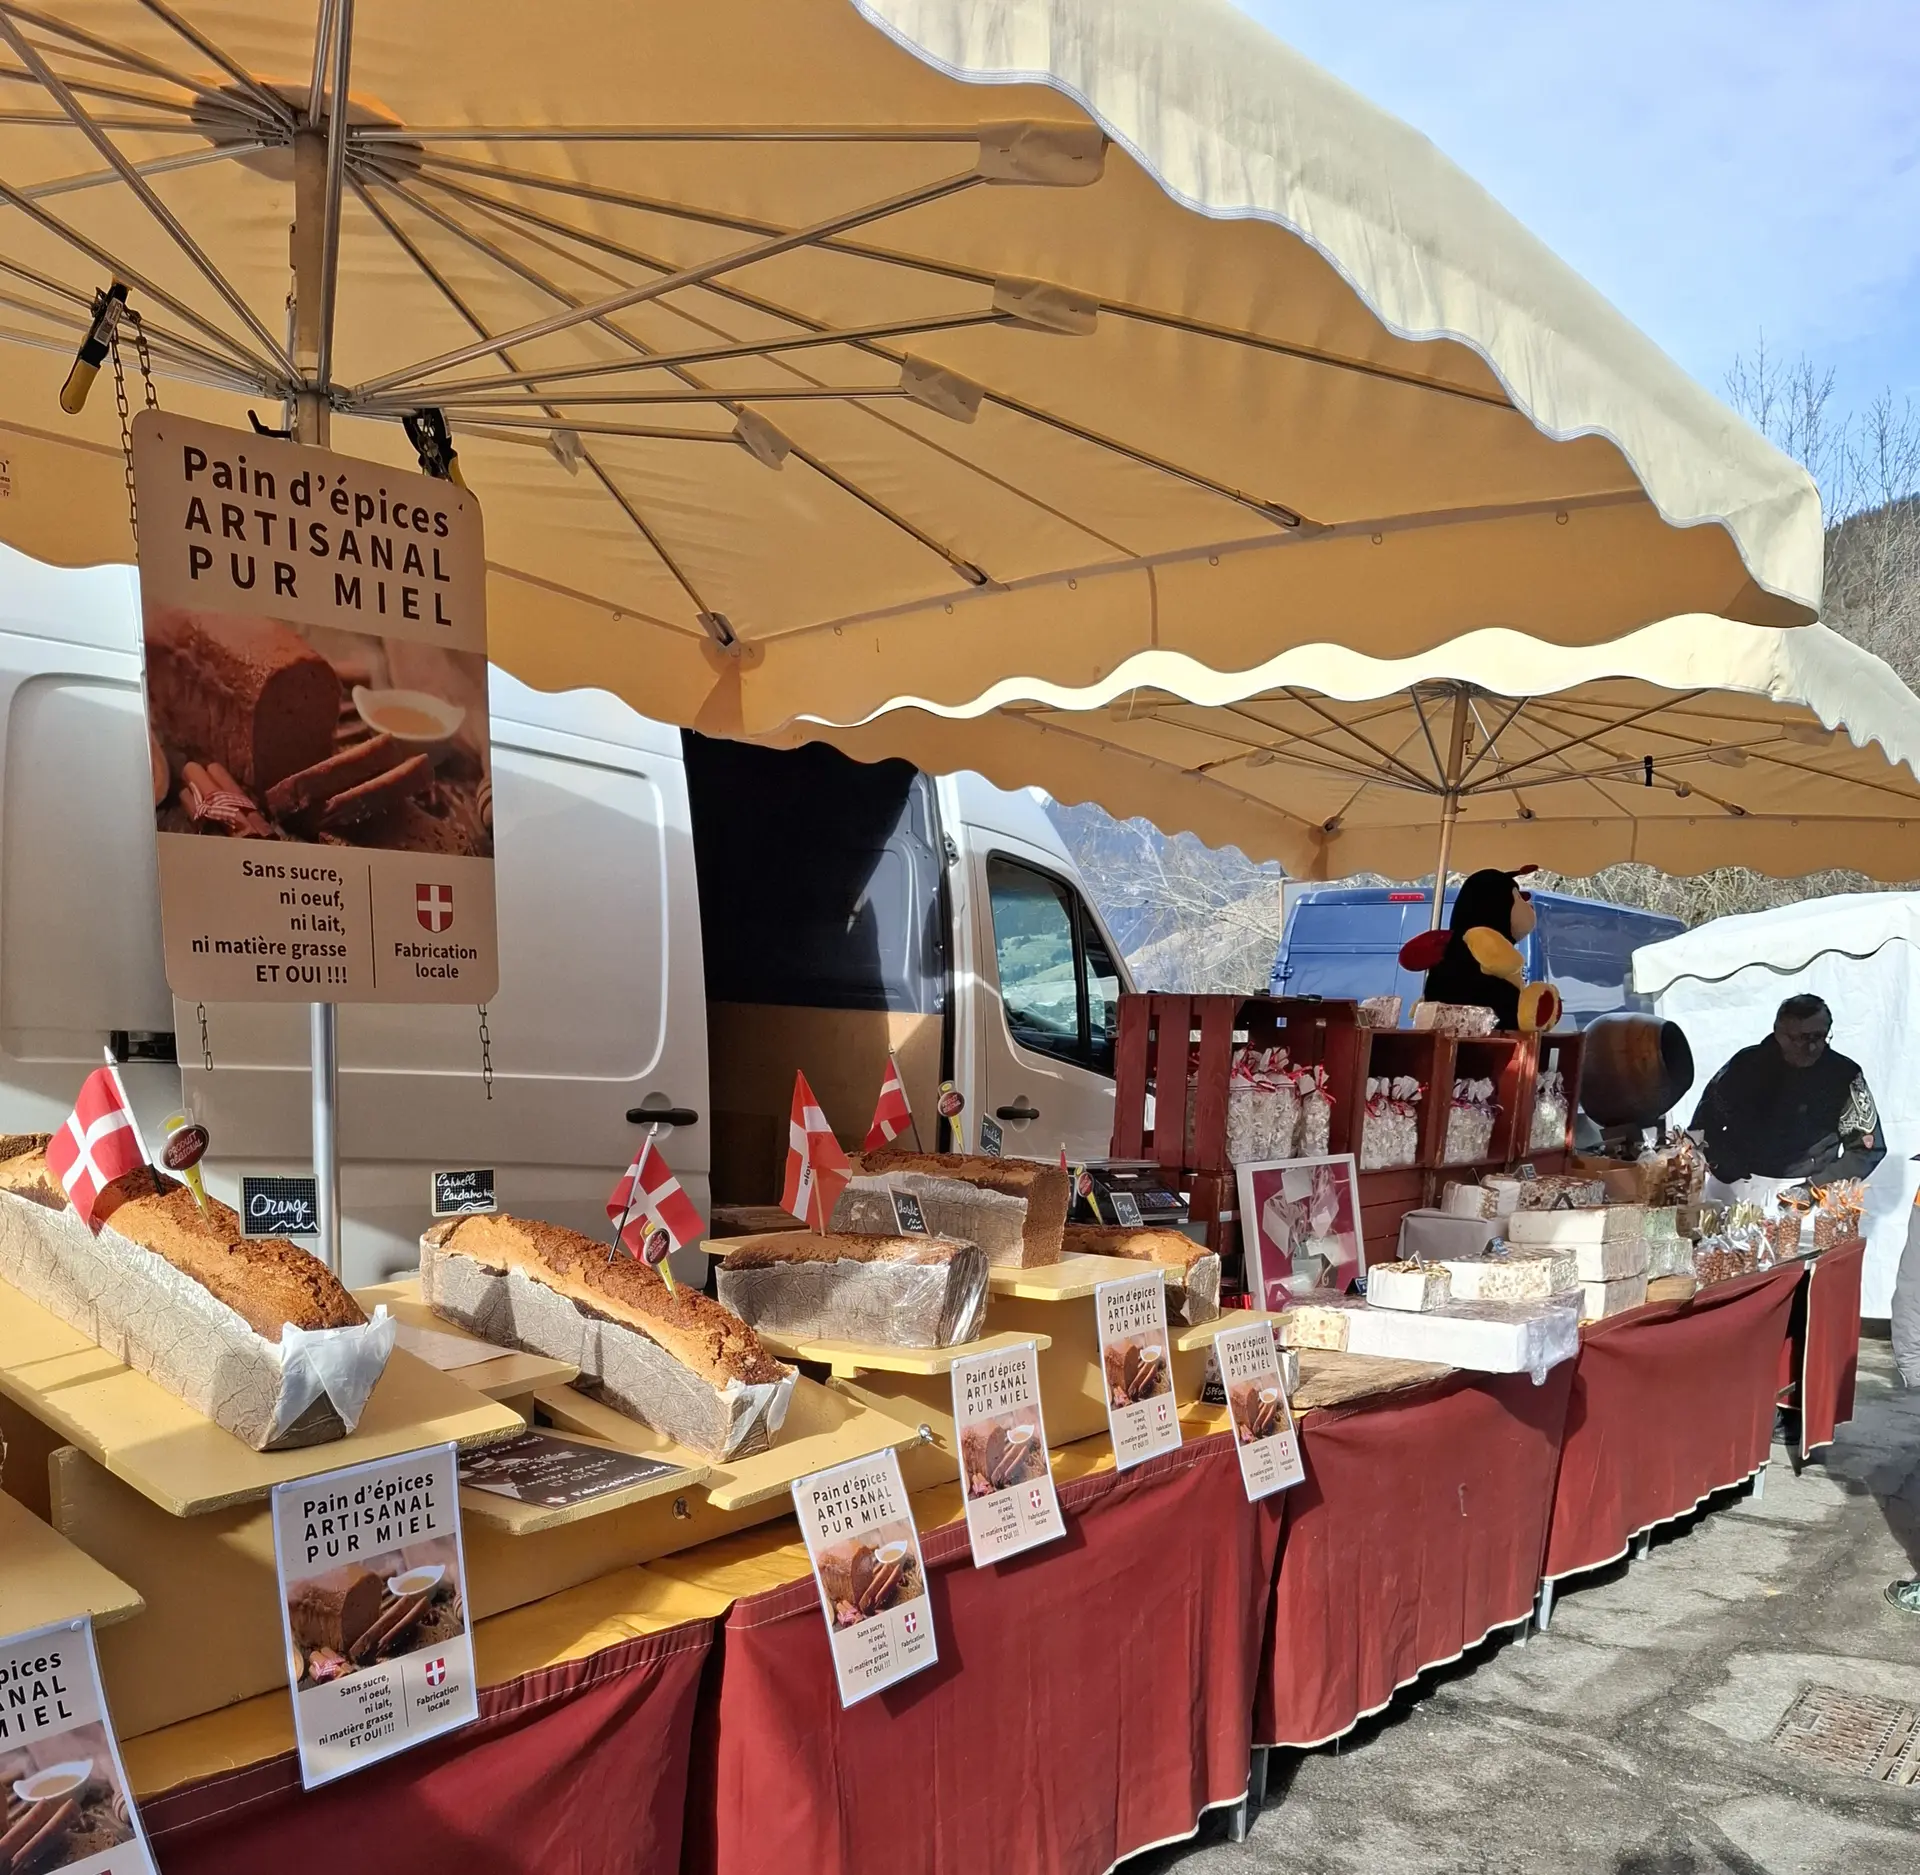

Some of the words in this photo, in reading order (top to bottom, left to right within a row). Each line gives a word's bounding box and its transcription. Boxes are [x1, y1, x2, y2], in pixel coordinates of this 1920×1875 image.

[184, 446, 275, 500] Pain
[290, 471, 449, 537] d'épices
[185, 497, 450, 582] ARTISANAL
[189, 545, 298, 598] PUR
[335, 573, 451, 626] MIEL
[242, 860, 285, 878] Sans
[290, 866, 343, 884] sucre,
[280, 889, 296, 904] ni
[302, 891, 344, 910] oeuf,
[291, 914, 306, 930] ni
[312, 914, 346, 935] lait,
[192, 936, 209, 952] ni
[215, 936, 286, 954] matière
[292, 943, 346, 960] grasse
[395, 943, 477, 959] Fabrication
[256, 965, 280, 982] ET
[286, 966, 320, 982] OUI
[328, 967, 347, 983] !!!
[416, 963, 459, 978] locale
[251, 1194, 311, 1222] Orange
[1108, 1293, 1124, 1306] Pain
[1109, 1300, 1156, 1320] ARTISANAL
[1110, 1320, 1129, 1334] PUR
[1135, 1313, 1157, 1327] MIEL
[1227, 1342, 1241, 1353] Pain
[1229, 1347, 1269, 1365] ARTISANAL
[966, 1370, 986, 1384] Pain
[989, 1361, 1026, 1378] d'épices
[1231, 1365, 1247, 1377] PUR
[1252, 1359, 1270, 1372] MIEL
[967, 1374, 1027, 1400] ARTISANAL
[969, 1399, 993, 1415] PUR
[1000, 1389, 1028, 1406] MIEL
[304, 1493, 348, 1518] Pain
[354, 1473, 433, 1505] d'épices
[813, 1486, 840, 1504] Pain
[843, 1472, 887, 1494] d'épices
[818, 1486, 891, 1521] ARTISANAL
[305, 1492, 434, 1541] ARTISANAL
[822, 1517, 853, 1537] PUR
[861, 1502, 896, 1523] MIEL
[307, 1534, 359, 1563] PUR
[376, 1514, 436, 1543] MIEL
[340, 1685, 361, 1696] Sans
[363, 1675, 389, 1688] sucre,
[359, 1694, 368, 1703] ni
[369, 1686, 390, 1700] oeuf,
[416, 1684, 459, 1706] Fabrication
[365, 1705, 373, 1714] ni
[375, 1700, 392, 1711] lait,
[428, 1698, 450, 1712] locale
[319, 1736, 328, 1746] ni
[330, 1721, 364, 1741] matière
[366, 1712, 393, 1728] grasse
[350, 1736, 362, 1748] ET
[364, 1728, 381, 1742] OUI
